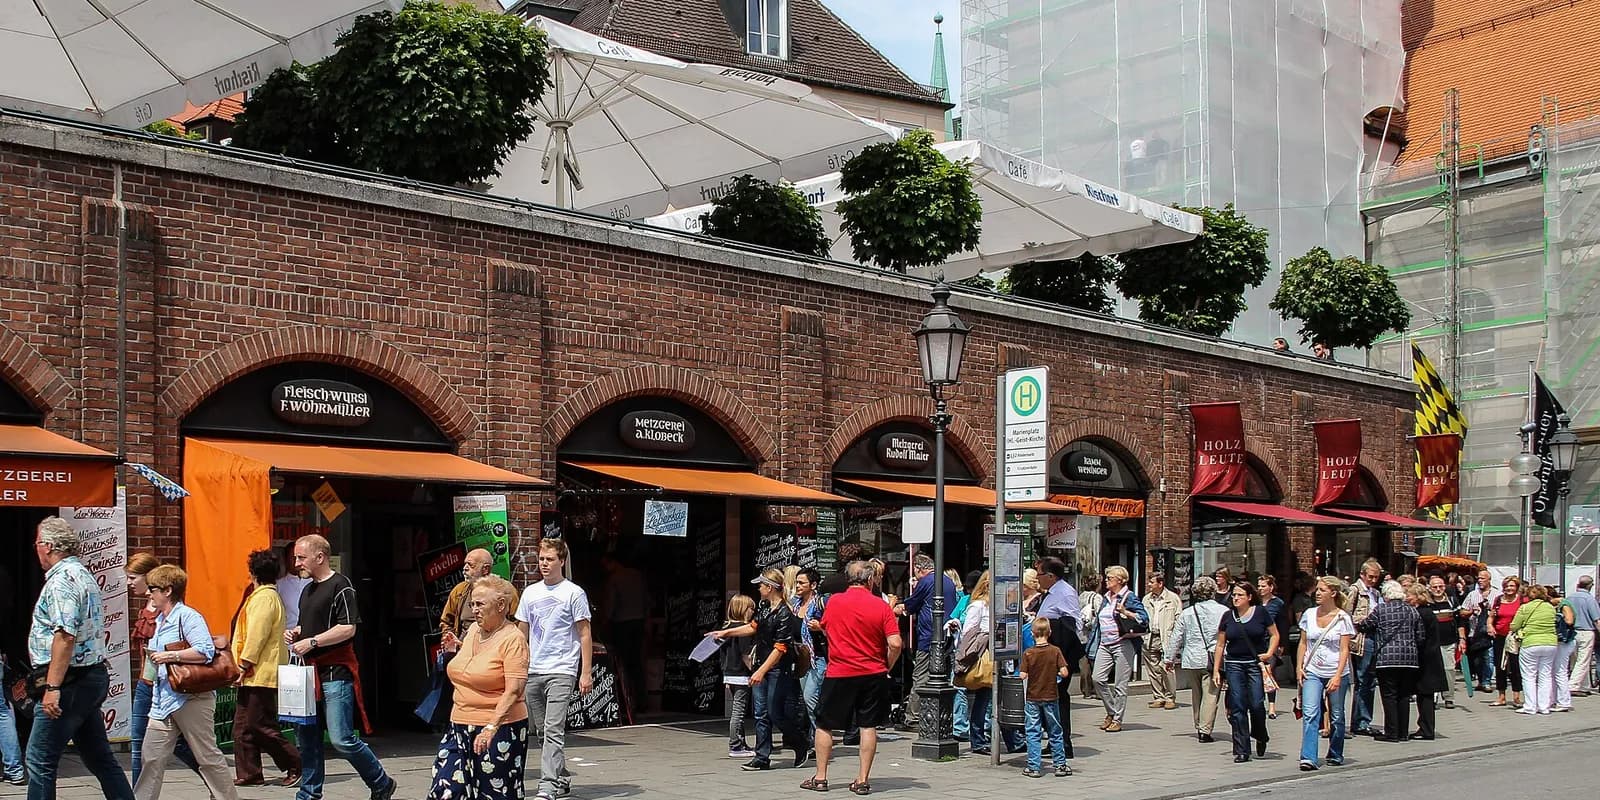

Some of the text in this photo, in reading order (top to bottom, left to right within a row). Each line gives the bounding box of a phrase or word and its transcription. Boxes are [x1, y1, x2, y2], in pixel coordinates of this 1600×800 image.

[1008, 160, 1028, 180] Café
[1204, 439, 1241, 451] HOLZ
[1198, 453, 1244, 466] LEUTE
[1326, 456, 1358, 467] HOLZ
[1322, 468, 1355, 480] LEUT
[429, 552, 459, 577] rivella
